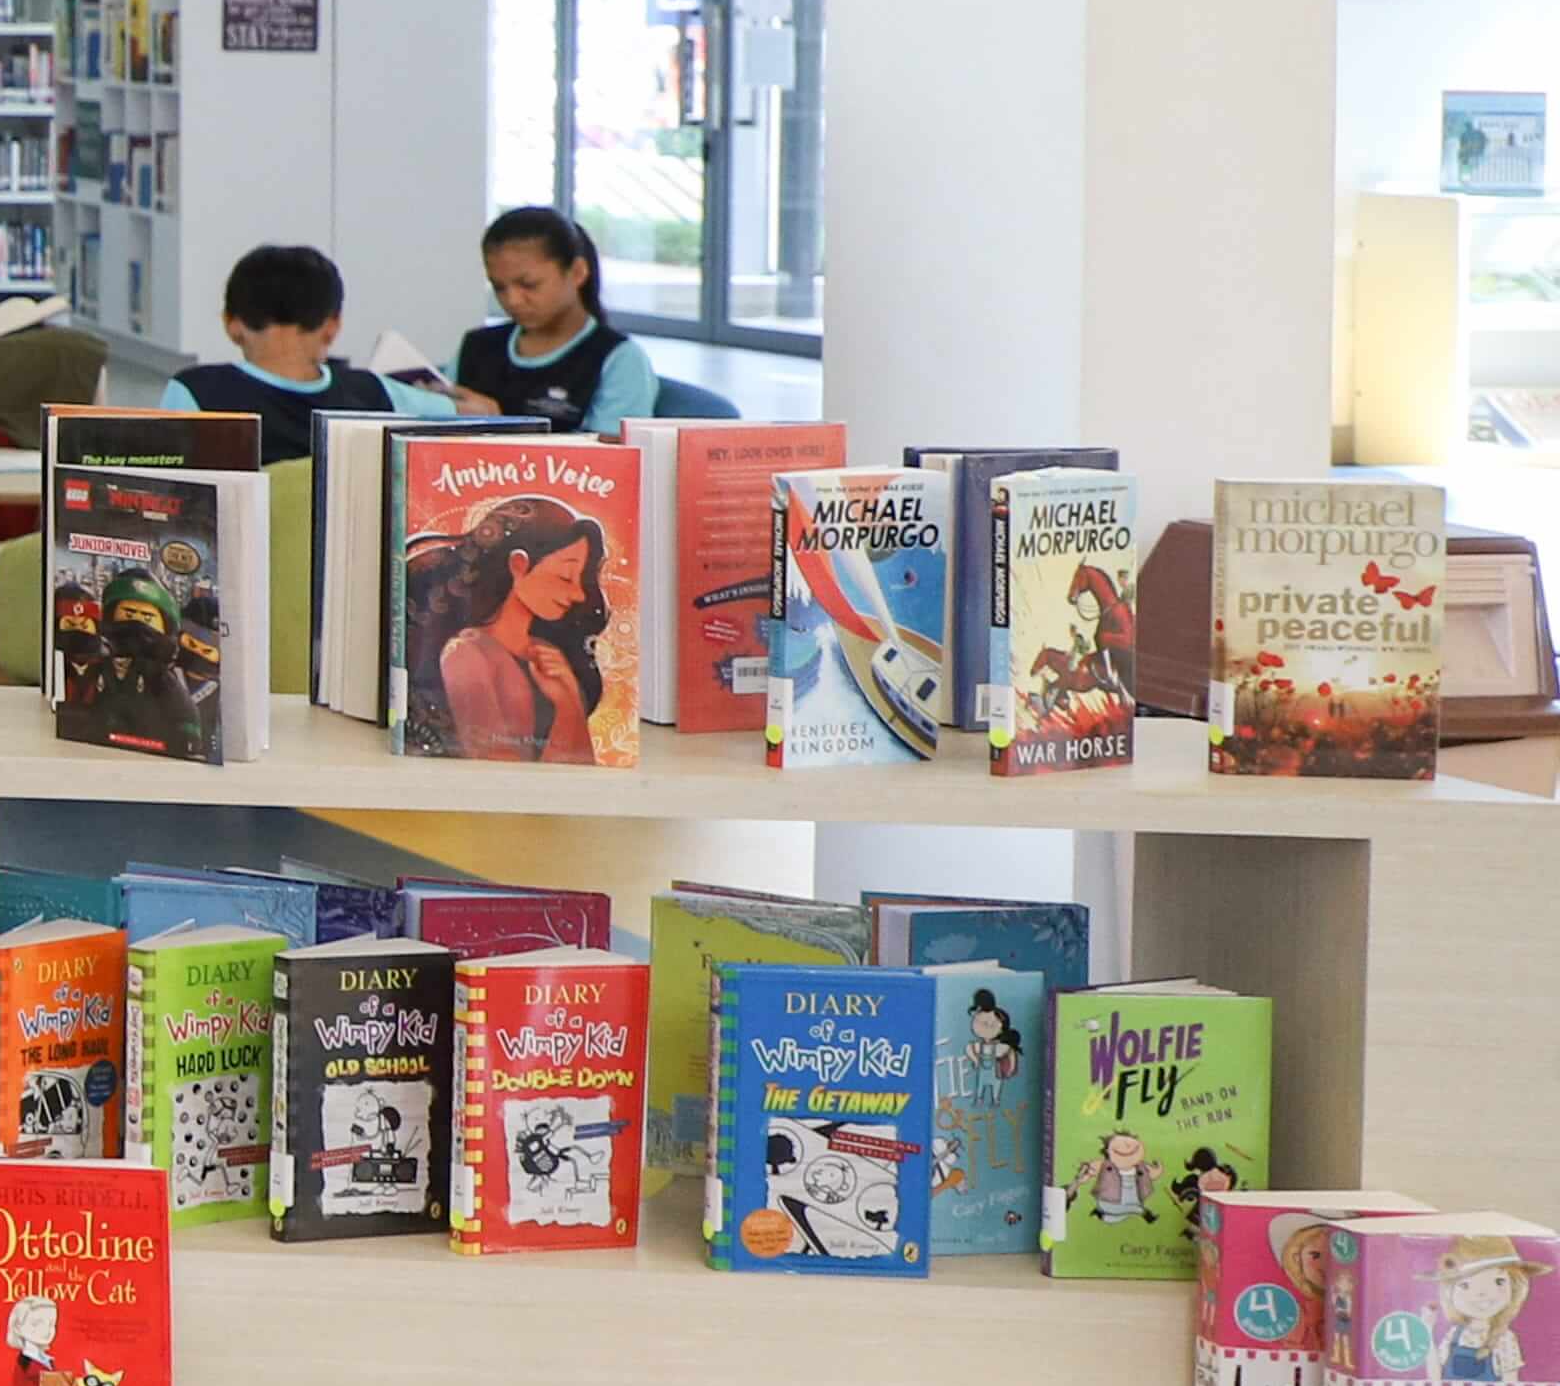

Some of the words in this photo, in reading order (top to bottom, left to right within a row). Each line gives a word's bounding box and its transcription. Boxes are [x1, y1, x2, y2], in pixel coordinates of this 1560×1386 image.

[432, 453, 538, 497] Amina's
[545, 455, 616, 499] Voice
[812, 497, 923, 524] MICHAEL
[1249, 490, 1416, 527] michael
[70, 534, 113, 554] JUNIOR
[114, 539, 151, 560] NOVEL
[797, 524, 940, 551] MORPURGO
[1236, 526, 1439, 569] morpurgo
[1239, 586, 1379, 618] private
[1257, 614, 1432, 645] peaceful
[791, 736, 875, 756] KINGDOM
[1017, 742, 1057, 765] WAR
[1065, 735, 1127, 761] HORSE
[784, 991, 883, 1018] DIARY
[175, 1048, 218, 1078] HARD
[220, 1044, 263, 1073] LUCK
[752, 1039, 855, 1082] Wimpy
[859, 1040, 912, 1078] Kid
[1089, 1010, 1204, 1089] WOLFIE
[324, 1060, 361, 1079] OLD
[365, 1055, 430, 1076] SCHOOL
[491, 1066, 572, 1092] DOUBLE
[576, 1066, 634, 1090] DOWN
[762, 1084, 802, 1112] THE
[808, 1084, 912, 1116] GETAWAY
[1115, 1062, 1180, 1120] FLY
[0, 1267, 80, 1304] Yellow
[87, 1271, 137, 1306] Cat
